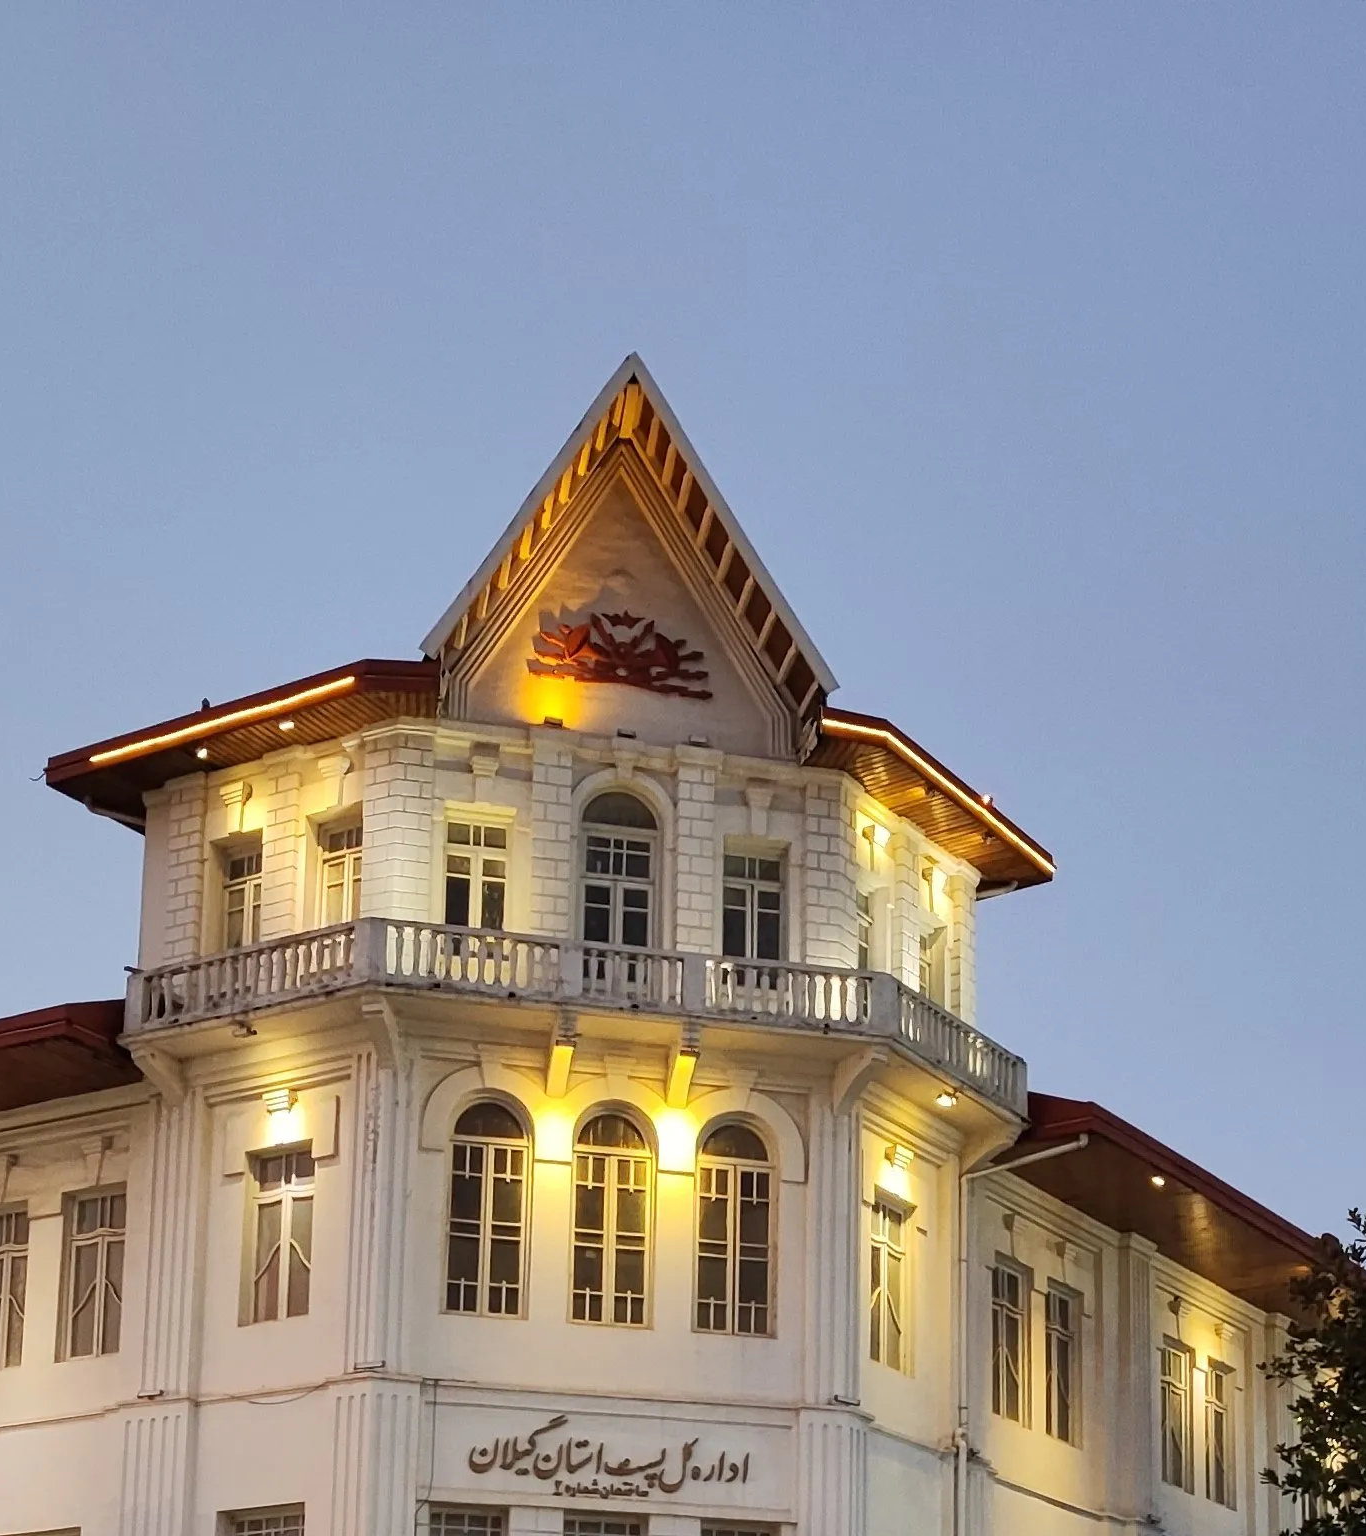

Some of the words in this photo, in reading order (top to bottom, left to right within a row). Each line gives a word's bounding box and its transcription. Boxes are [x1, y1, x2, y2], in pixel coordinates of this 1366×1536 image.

[468, 1413, 571, 1478] گیلان
[533, 1435, 604, 1480] استان
[657, 1436, 699, 1494] کل
[564, 1478, 600, 1498] شماره
[603, 1446, 666, 1488] پست
[689, 1450, 750, 1484] اداره
[599, 1481, 650, 1499] ساختمان
